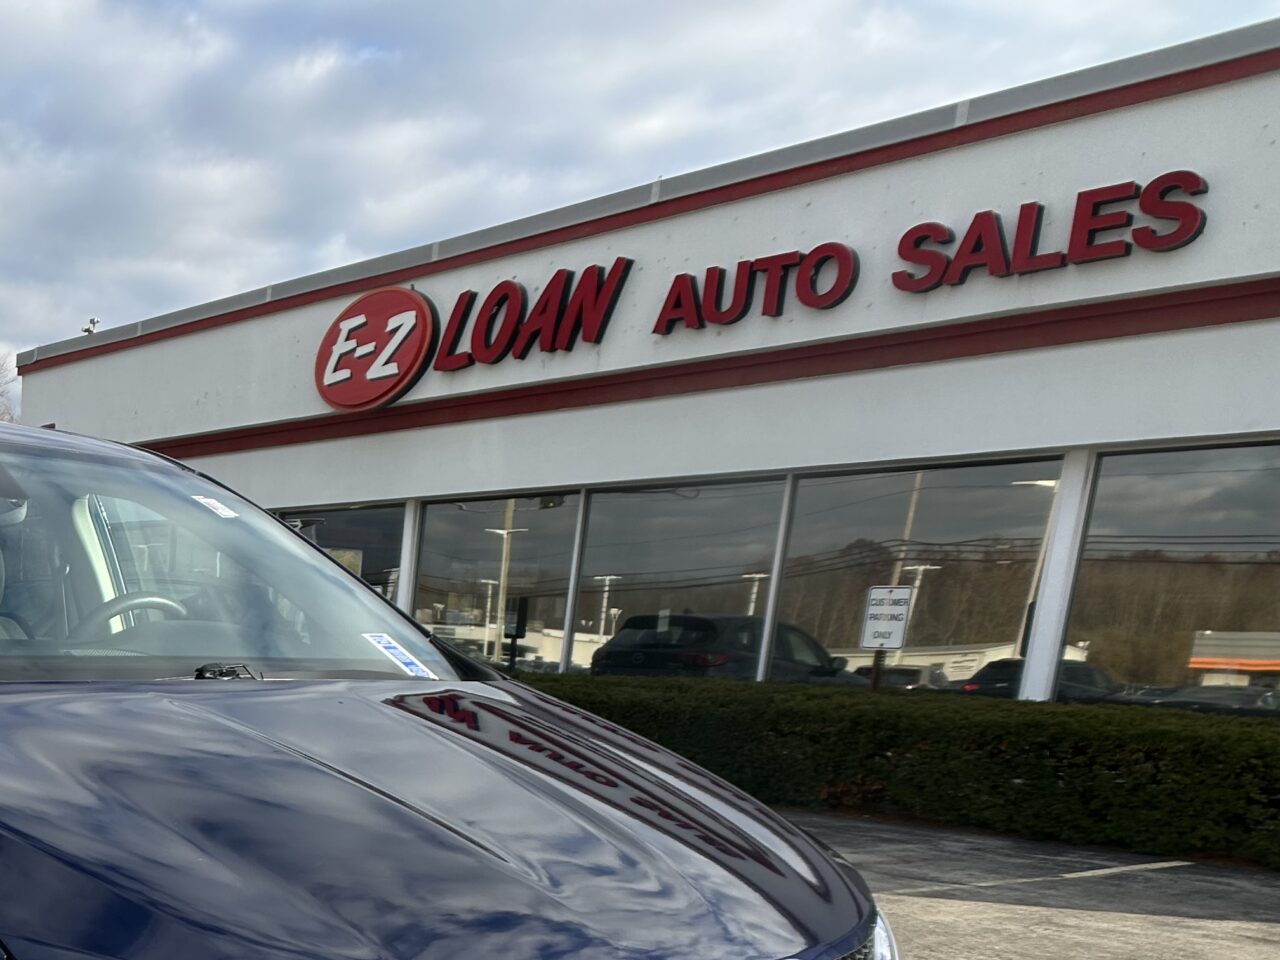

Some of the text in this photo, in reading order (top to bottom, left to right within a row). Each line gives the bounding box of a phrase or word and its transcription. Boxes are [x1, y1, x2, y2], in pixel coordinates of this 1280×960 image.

[323, 169, 1209, 386] E-Z LOAN AUTO SALES
[873, 631, 893, 639] ONLY
